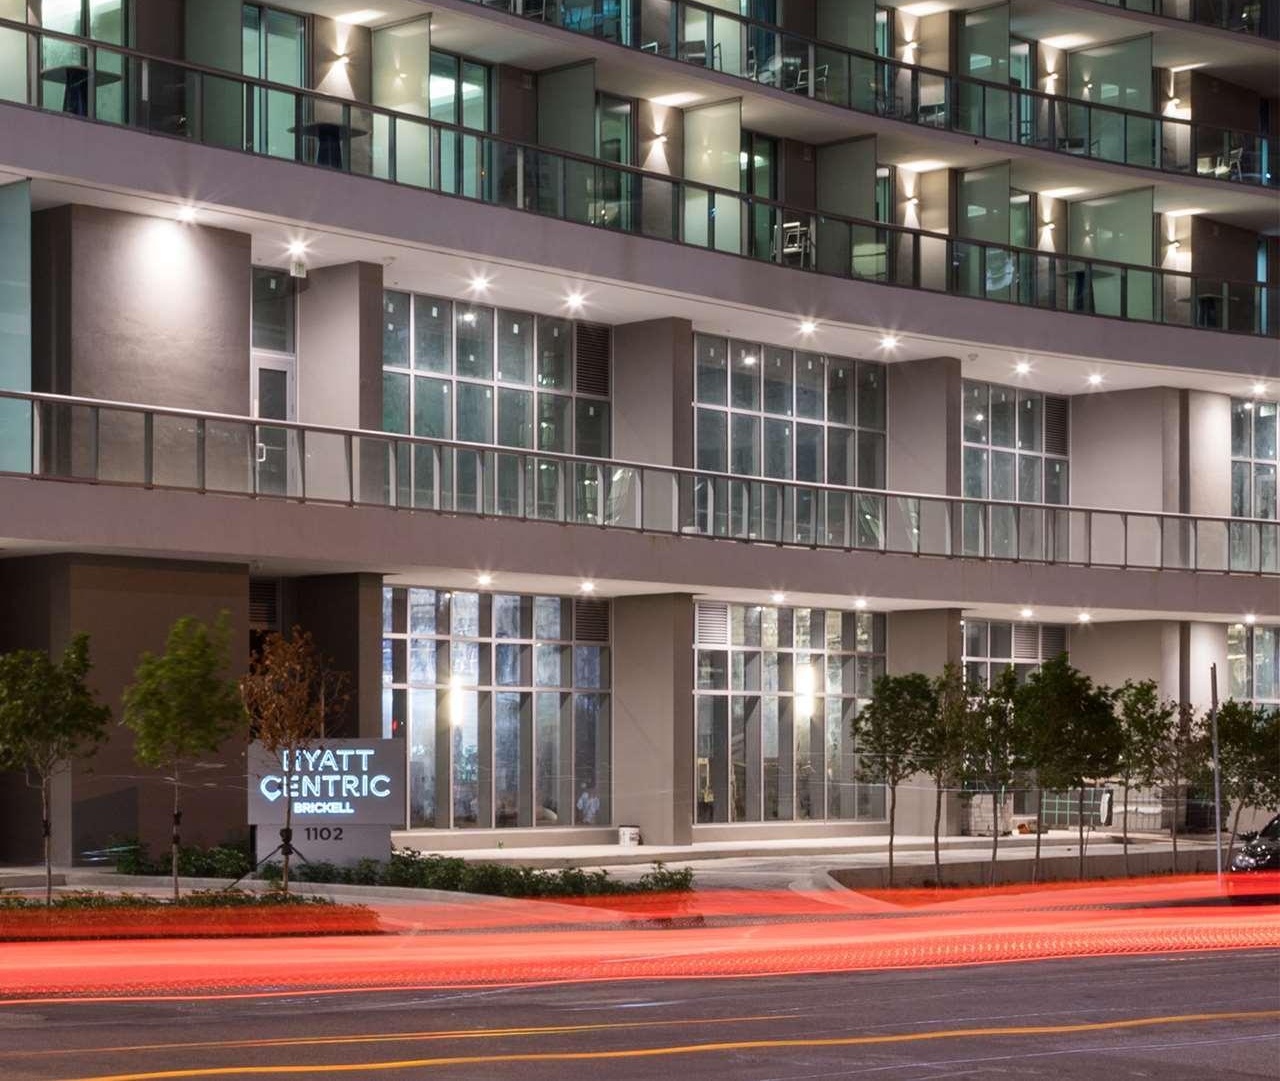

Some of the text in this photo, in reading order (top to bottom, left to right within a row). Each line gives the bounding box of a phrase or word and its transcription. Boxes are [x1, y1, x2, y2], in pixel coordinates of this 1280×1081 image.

[282, 749, 375, 772] HYATT
[260, 774, 391, 802] CENTRIC
[293, 801, 354, 814] BRICKELL
[304, 827, 344, 841] 1102
